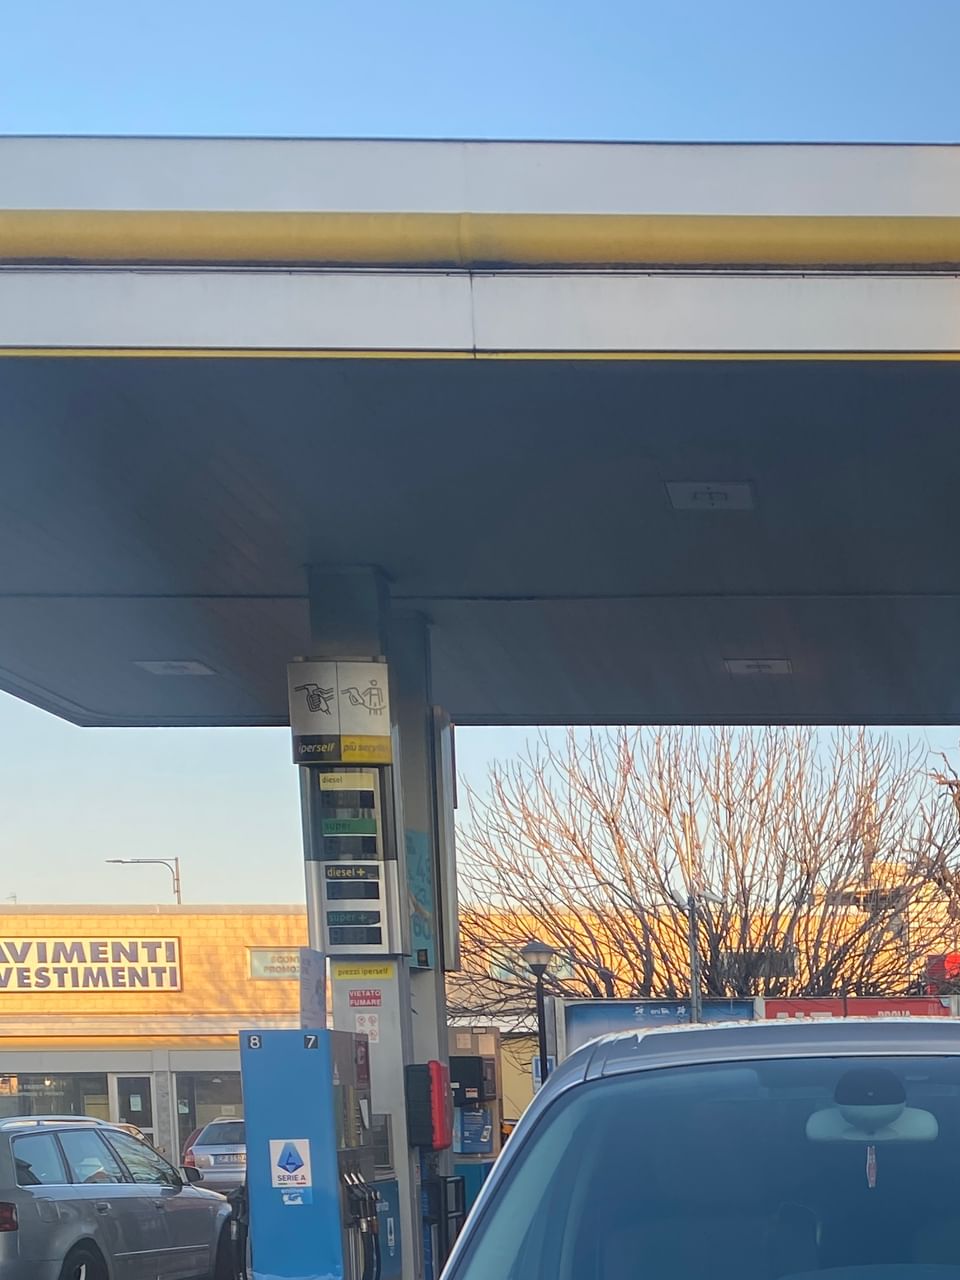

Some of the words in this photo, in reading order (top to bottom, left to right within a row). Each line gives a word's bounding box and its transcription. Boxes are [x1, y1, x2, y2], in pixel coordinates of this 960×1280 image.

[299, 742, 335, 753] iperself
[321, 776, 342, 784] diesel
[350, 990, 381, 998] VIETATO
[249, 1035, 260, 1048] 8
[305, 1035, 316, 1049] 7
